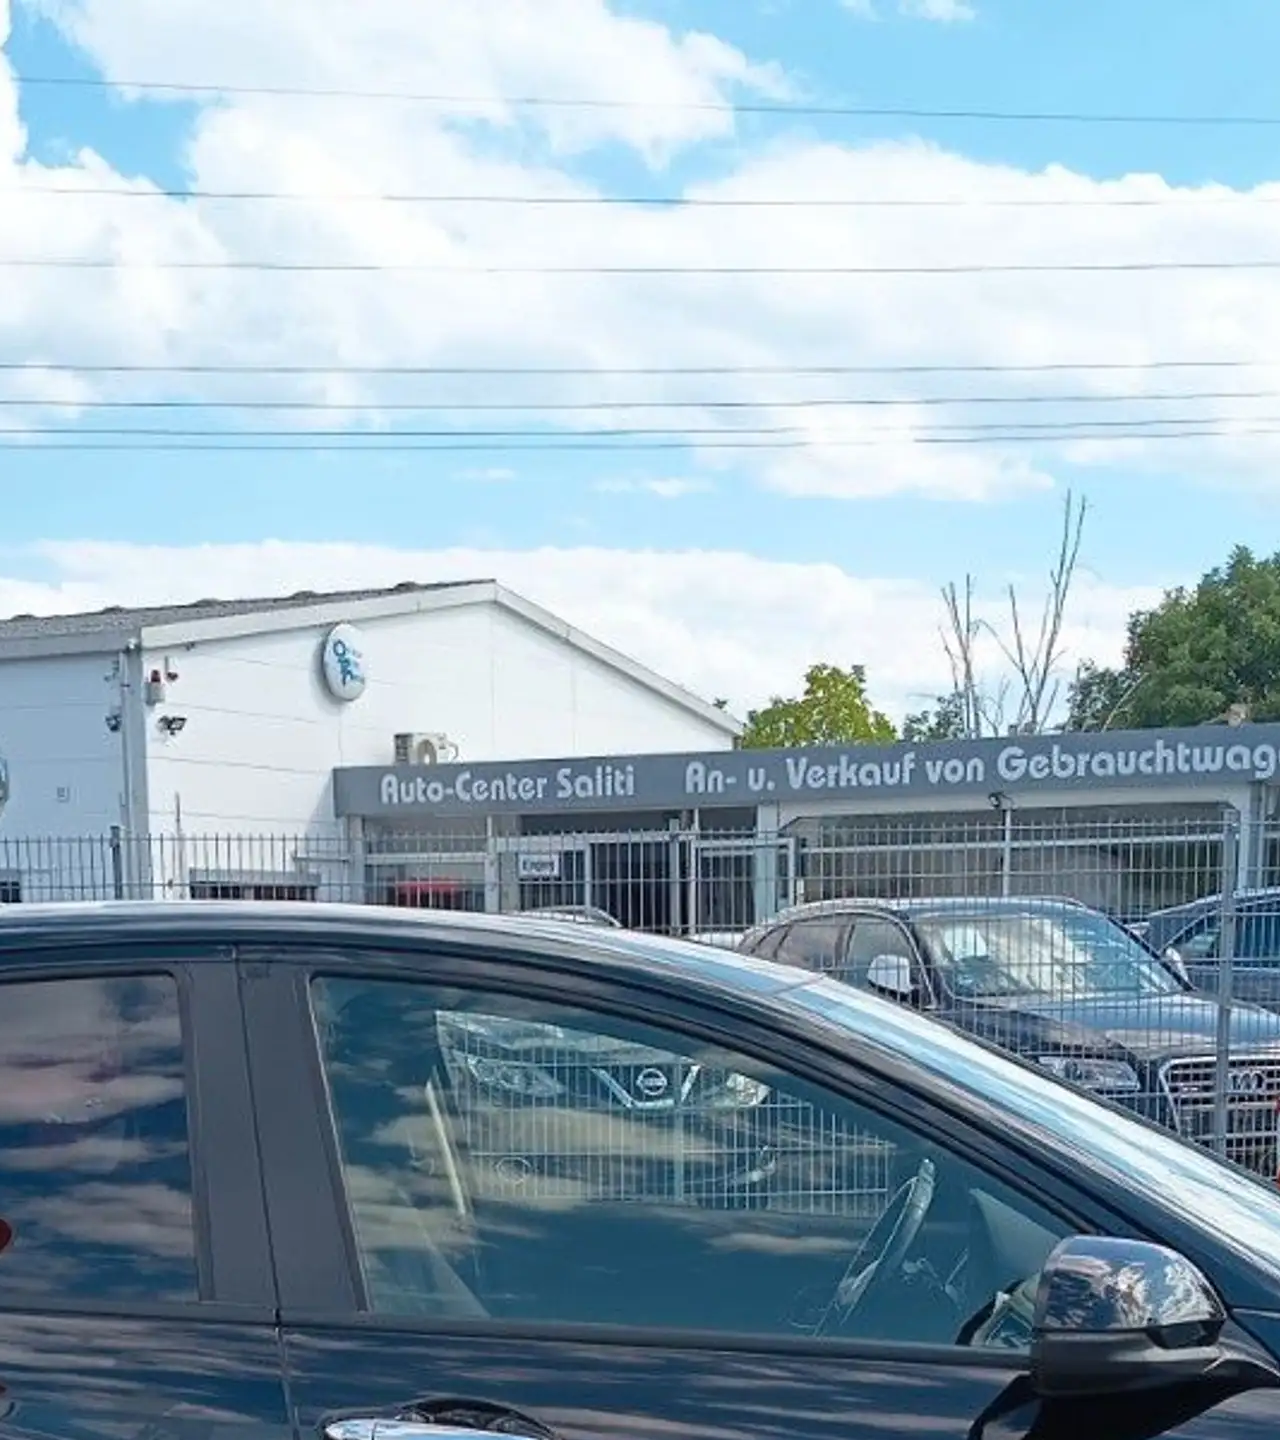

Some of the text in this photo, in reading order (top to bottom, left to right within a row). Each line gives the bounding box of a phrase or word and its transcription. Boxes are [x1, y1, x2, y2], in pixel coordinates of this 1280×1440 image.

[380, 771, 548, 804] Auto-Center
[556, 765, 635, 799] Saliti
[685, 761, 737, 794] An-
[747, 767, 776, 792] u.
[785, 752, 916, 790] Verkauf
[924, 756, 986, 785] von
